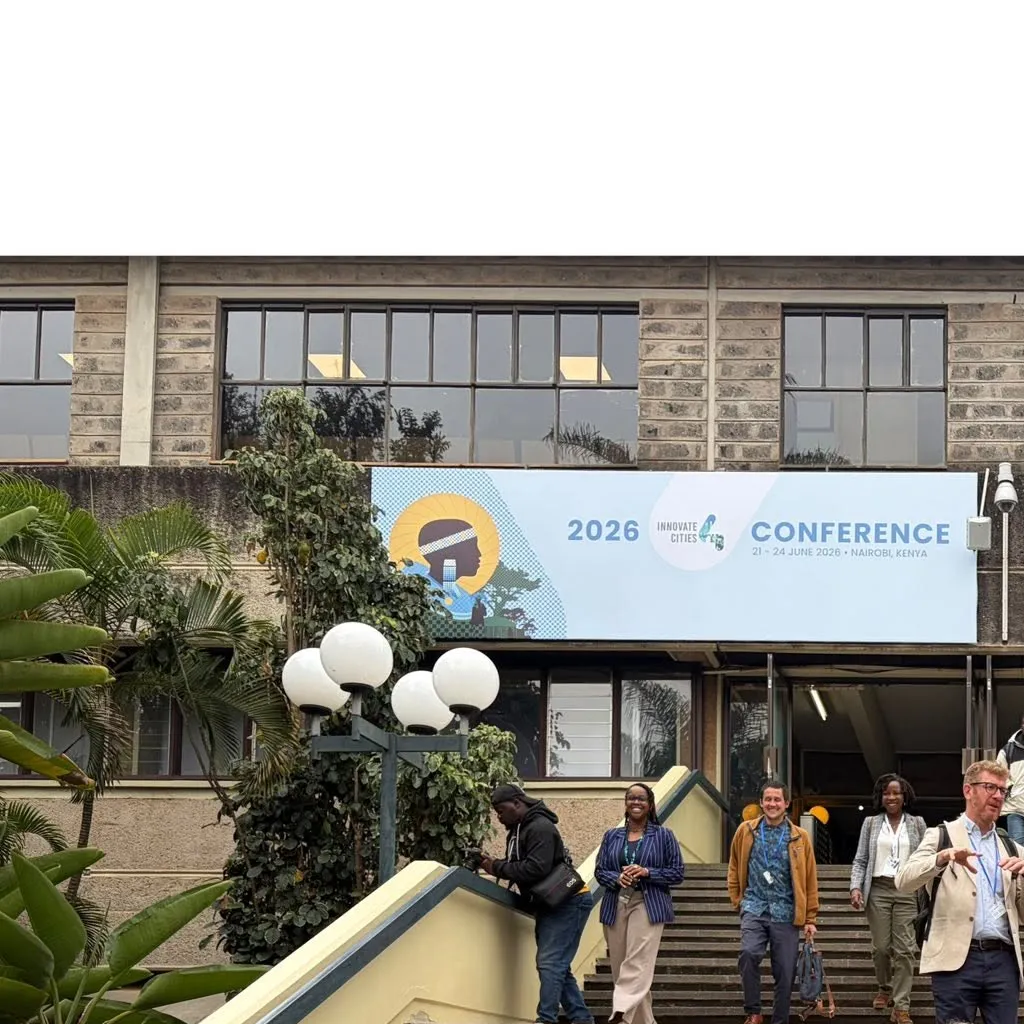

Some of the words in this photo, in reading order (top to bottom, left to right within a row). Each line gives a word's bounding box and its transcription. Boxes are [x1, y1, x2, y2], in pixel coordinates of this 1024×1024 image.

[567, 519, 640, 542] 2026
[657, 521, 698, 532] INNOVATE
[670, 533, 698, 543] CITIES
[751, 521, 950, 545] CONFERENCE
[752, 547, 762, 556] 21
[773, 547, 785, 556] 24
[788, 547, 813, 556] JUNE
[816, 547, 841, 557] 2026
[851, 548, 893, 558] NAIROBI,
[896, 549, 928, 558] KENYA
